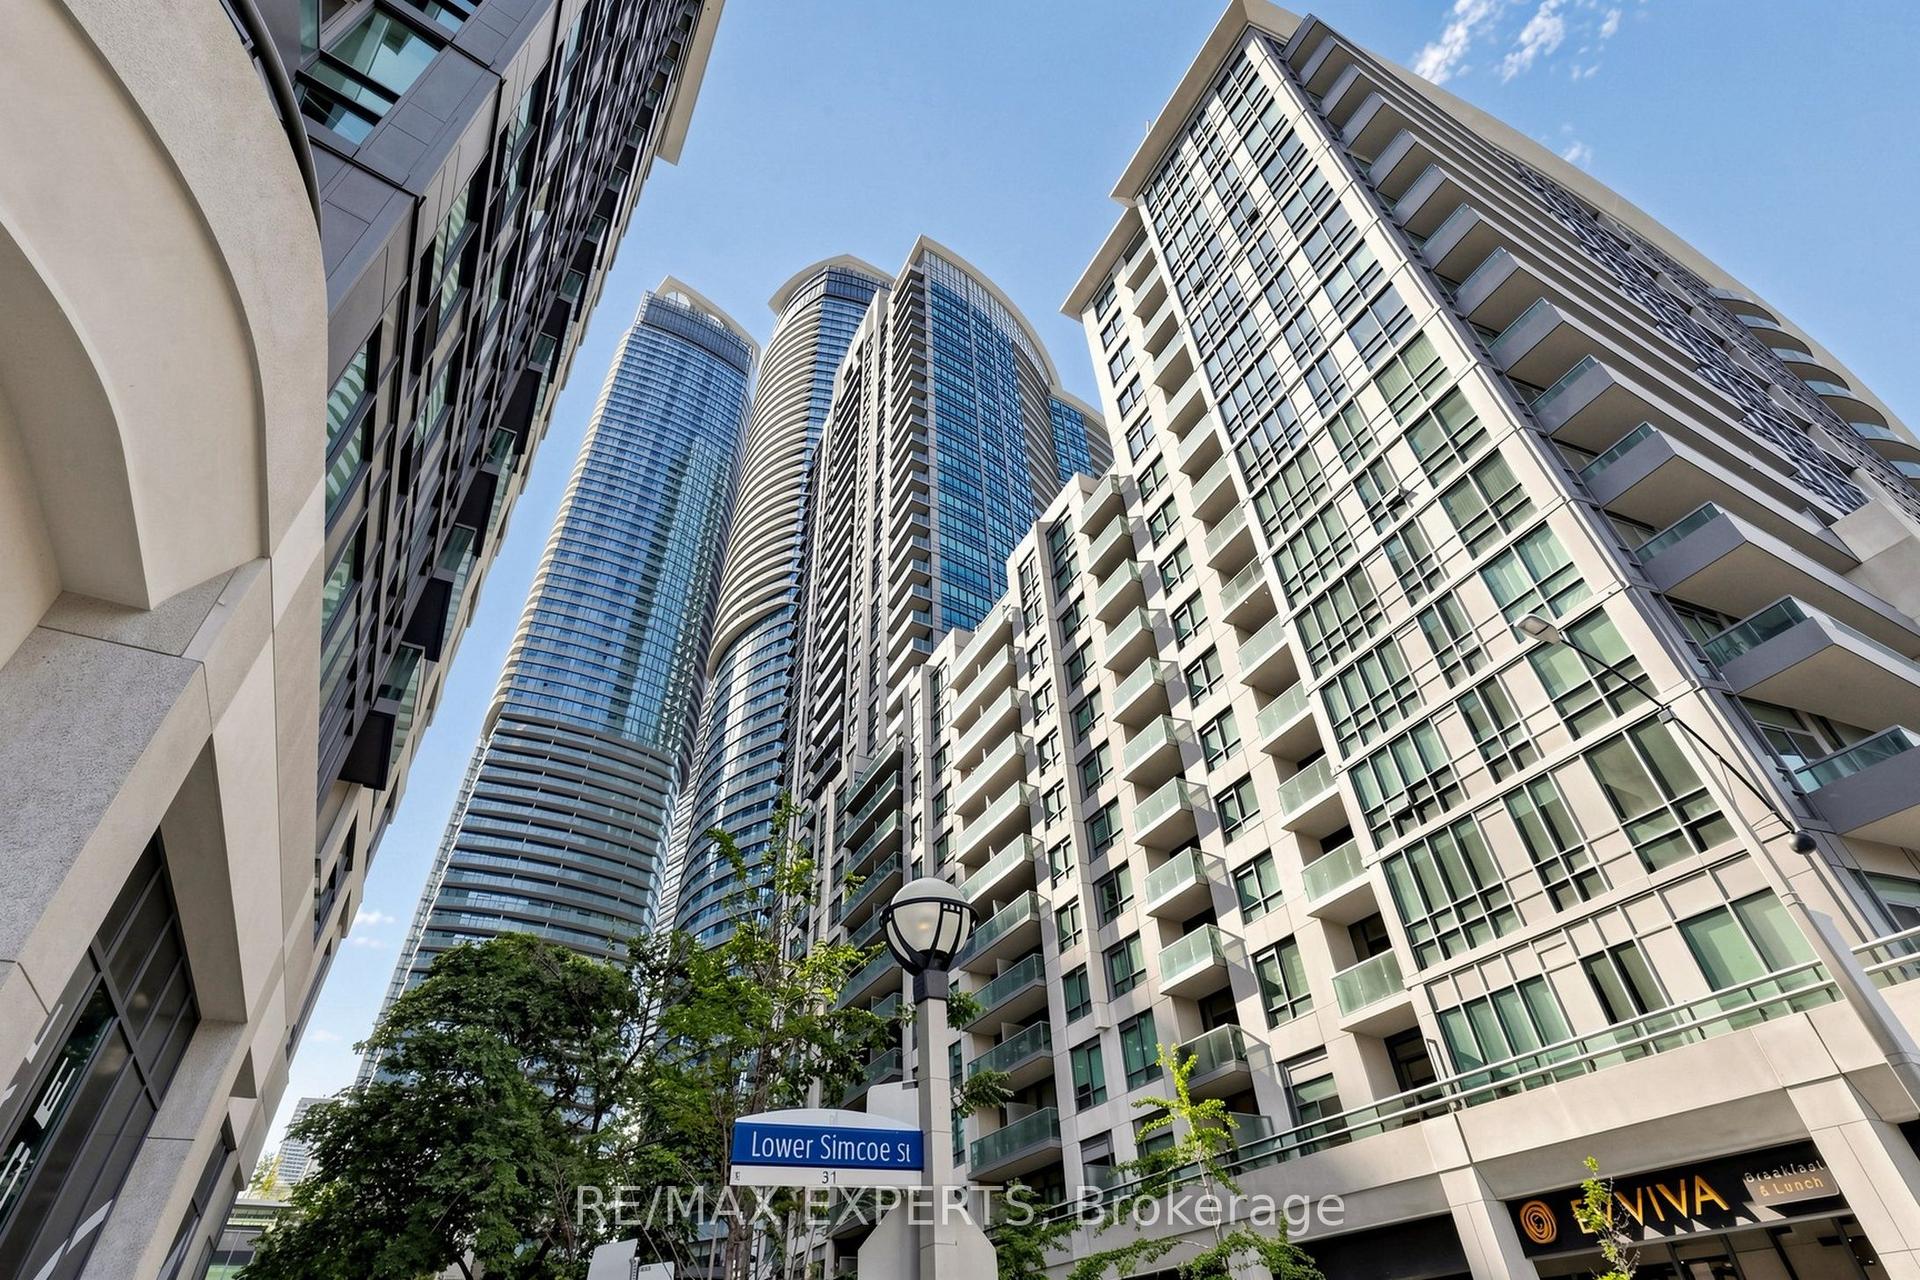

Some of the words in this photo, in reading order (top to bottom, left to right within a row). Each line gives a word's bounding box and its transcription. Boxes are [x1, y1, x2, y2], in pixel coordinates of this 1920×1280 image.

[752, 1131, 814, 1159] Lower
[820, 1134, 891, 1163] Simcoe
[896, 1142, 911, 1163] St
[821, 1170, 836, 1185] 31
[1744, 1160, 1824, 1183] Breakfast
[1759, 1185, 1770, 1197] &
[1773, 1176, 1824, 1195] Lunch
